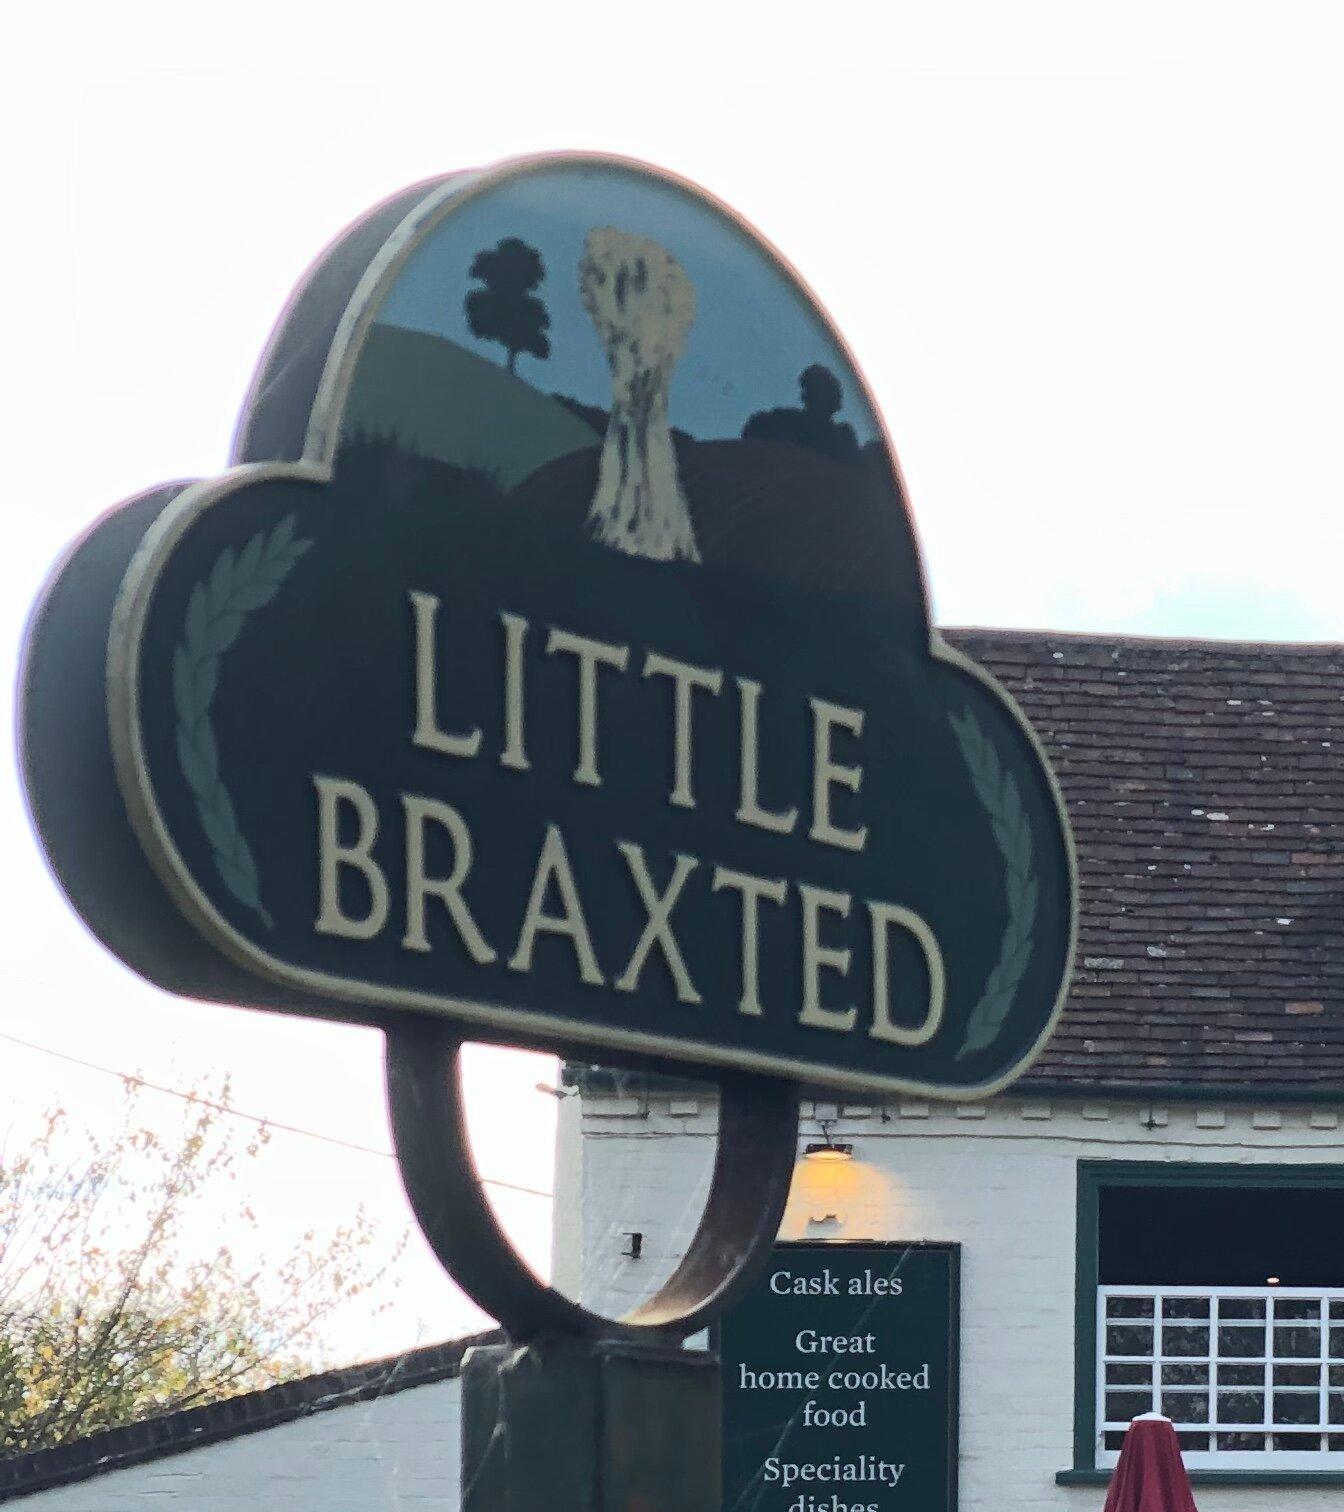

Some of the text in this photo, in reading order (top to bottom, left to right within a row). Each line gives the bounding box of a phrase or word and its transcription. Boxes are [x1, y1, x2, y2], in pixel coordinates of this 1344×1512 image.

[409, 591, 868, 852] LITTLE
[312, 774, 947, 1047] BRAXTED
[769, 1269, 904, 1296] Cask ales
[795, 1329, 876, 1354] Great
[738, 1363, 931, 1390] home cooked
[802, 1400, 867, 1427] food
[763, 1455, 905, 1488] Speciality
